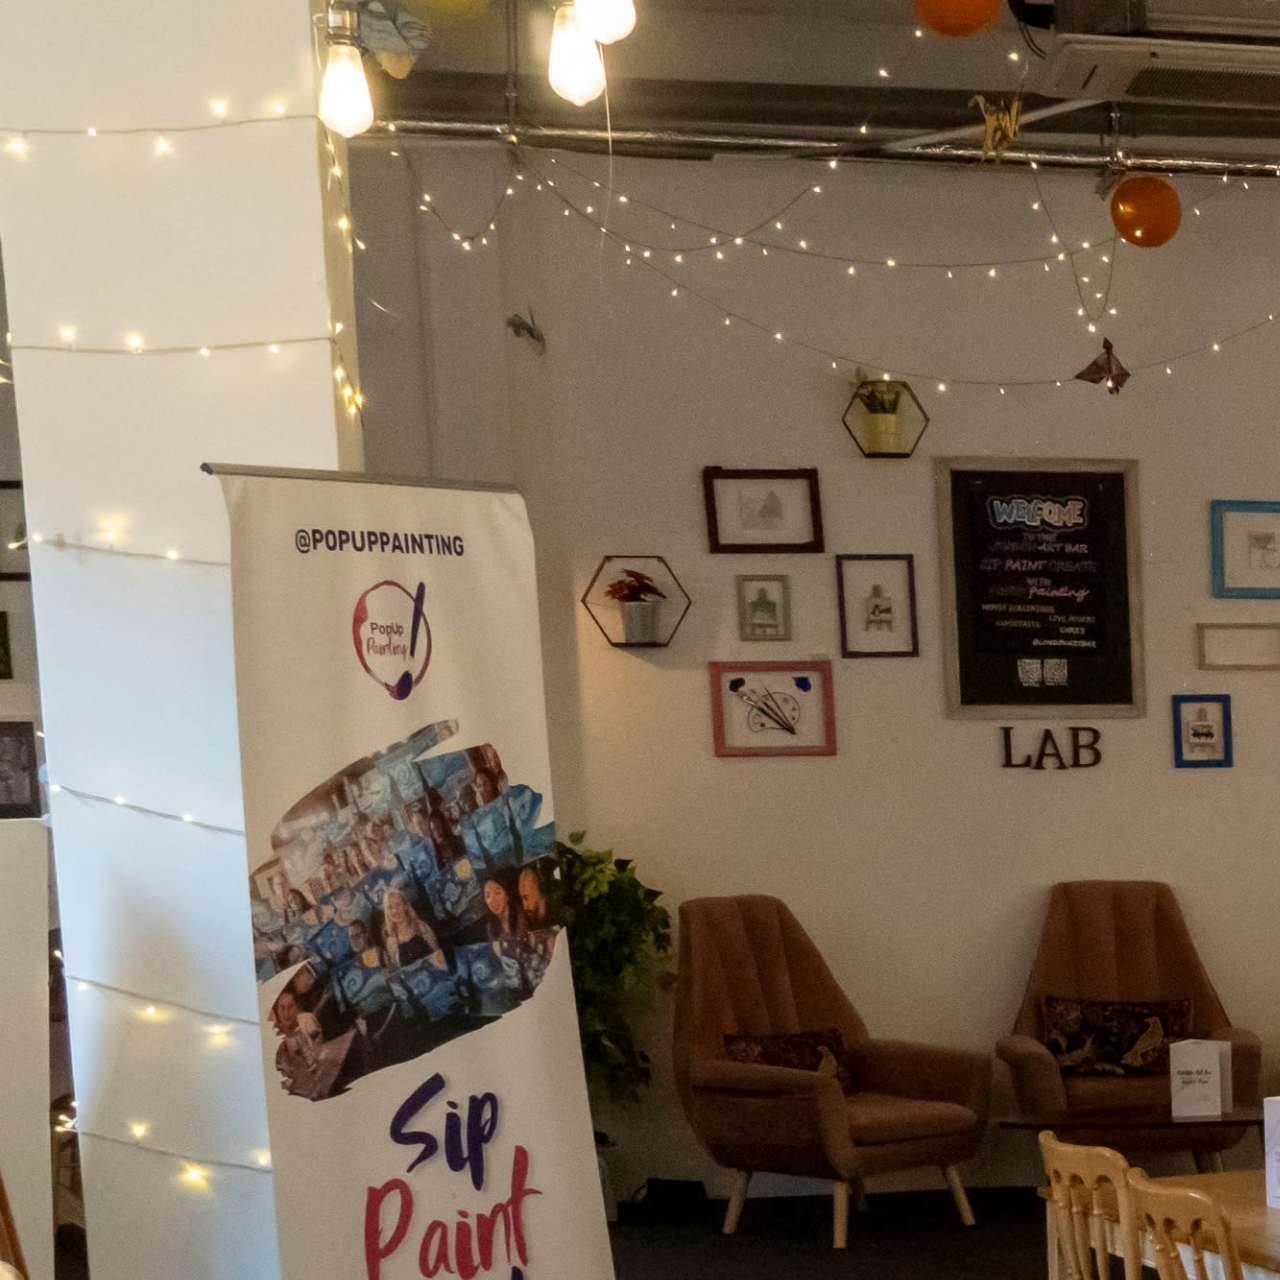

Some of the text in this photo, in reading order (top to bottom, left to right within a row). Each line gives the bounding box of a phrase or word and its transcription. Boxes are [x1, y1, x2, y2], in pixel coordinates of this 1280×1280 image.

[992, 498, 1086, 528] WELCOME
[295, 529, 465, 557] @POPUPPAINTING
[1005, 559, 1047, 571] PAINT
[369, 621, 405, 637] PopUp
[999, 726, 1102, 771] LAB
[390, 1072, 499, 1191] Sip
